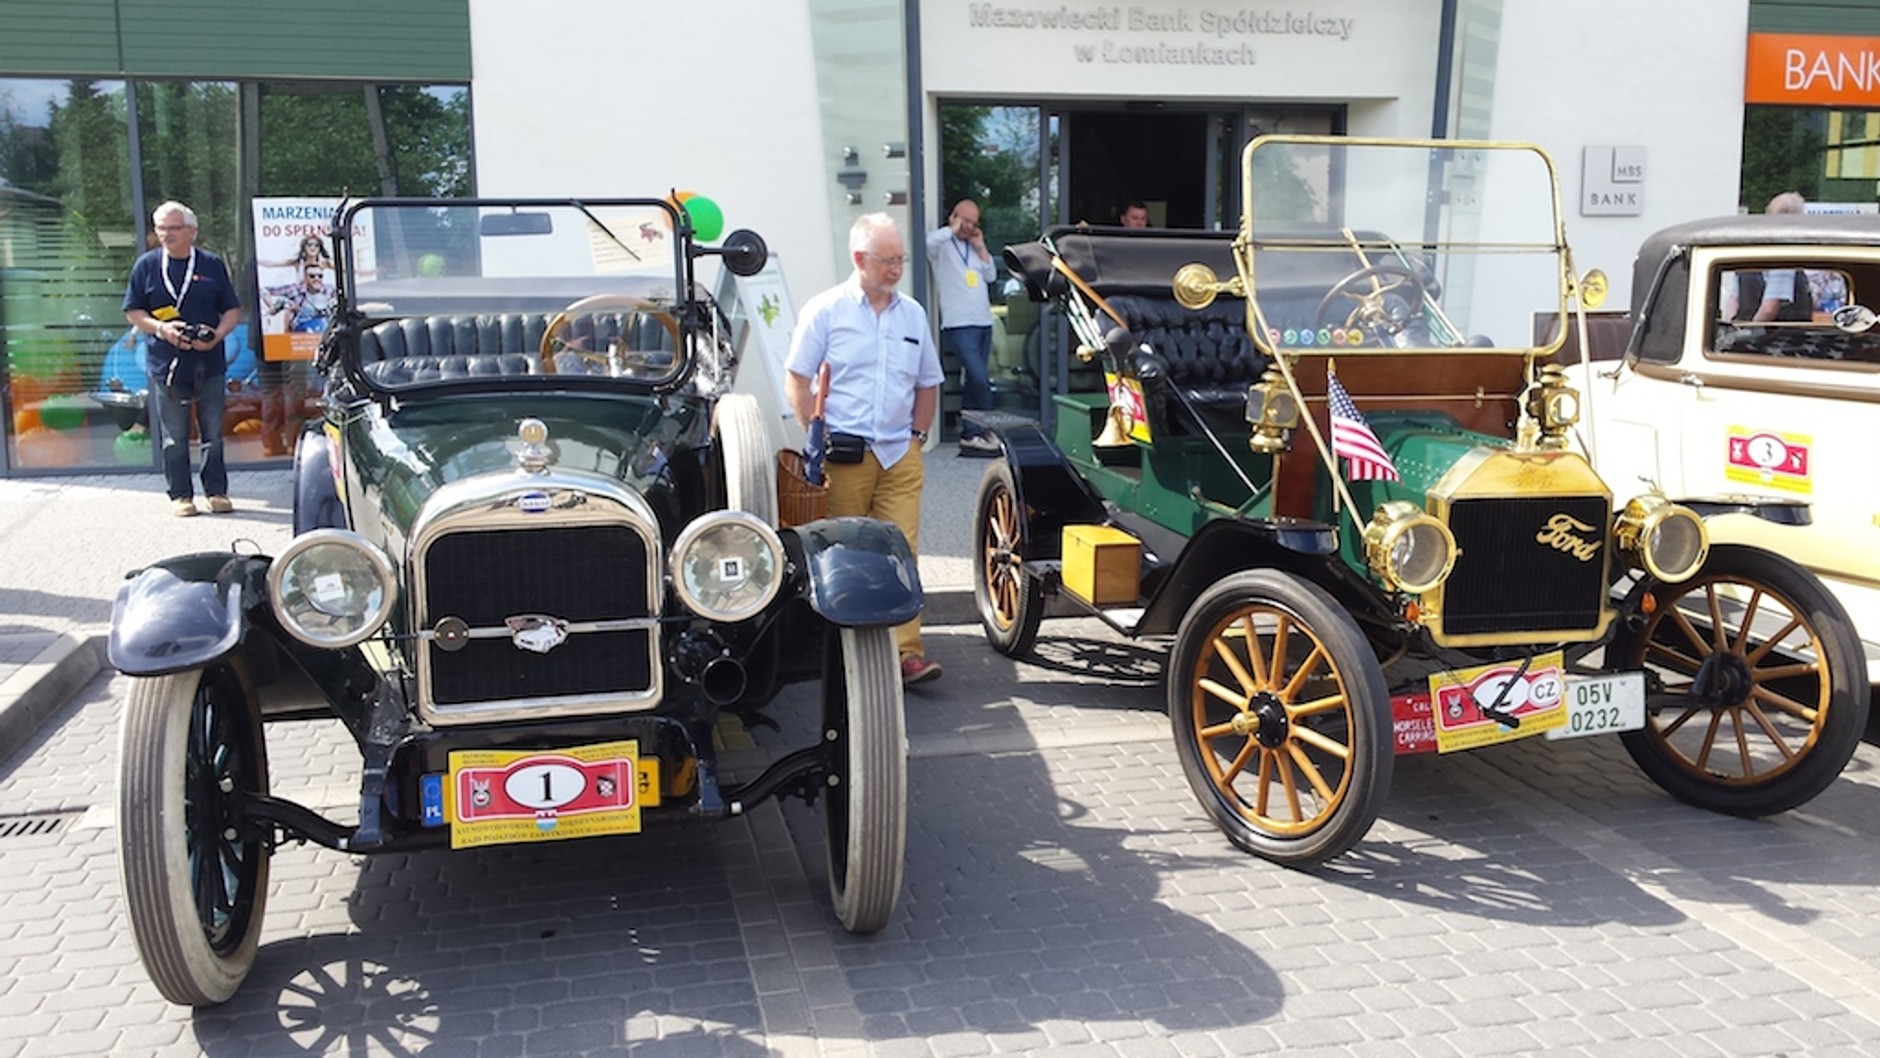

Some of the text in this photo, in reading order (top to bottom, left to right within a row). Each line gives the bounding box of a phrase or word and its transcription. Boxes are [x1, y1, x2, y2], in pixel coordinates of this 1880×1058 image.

[969, 3, 1355, 41] Mazowiecki Bank Spółdzielczy
[1074, 41, 1257, 66] w Łomiankach
[1617, 165, 1642, 177] MBS
[1590, 193, 1637, 205] BANK
[262, 225, 282, 237] DO
[1762, 441, 1773, 463] 3
[1536, 513, 1603, 561] Ford
[1535, 681, 1556, 700] CZ
[1576, 682, 1613, 707] 05V
[1413, 702, 1432, 713] CAL
[1571, 708, 1620, 733] 0232
[538, 771, 556, 803] 1
[426, 806, 441, 818] PL
